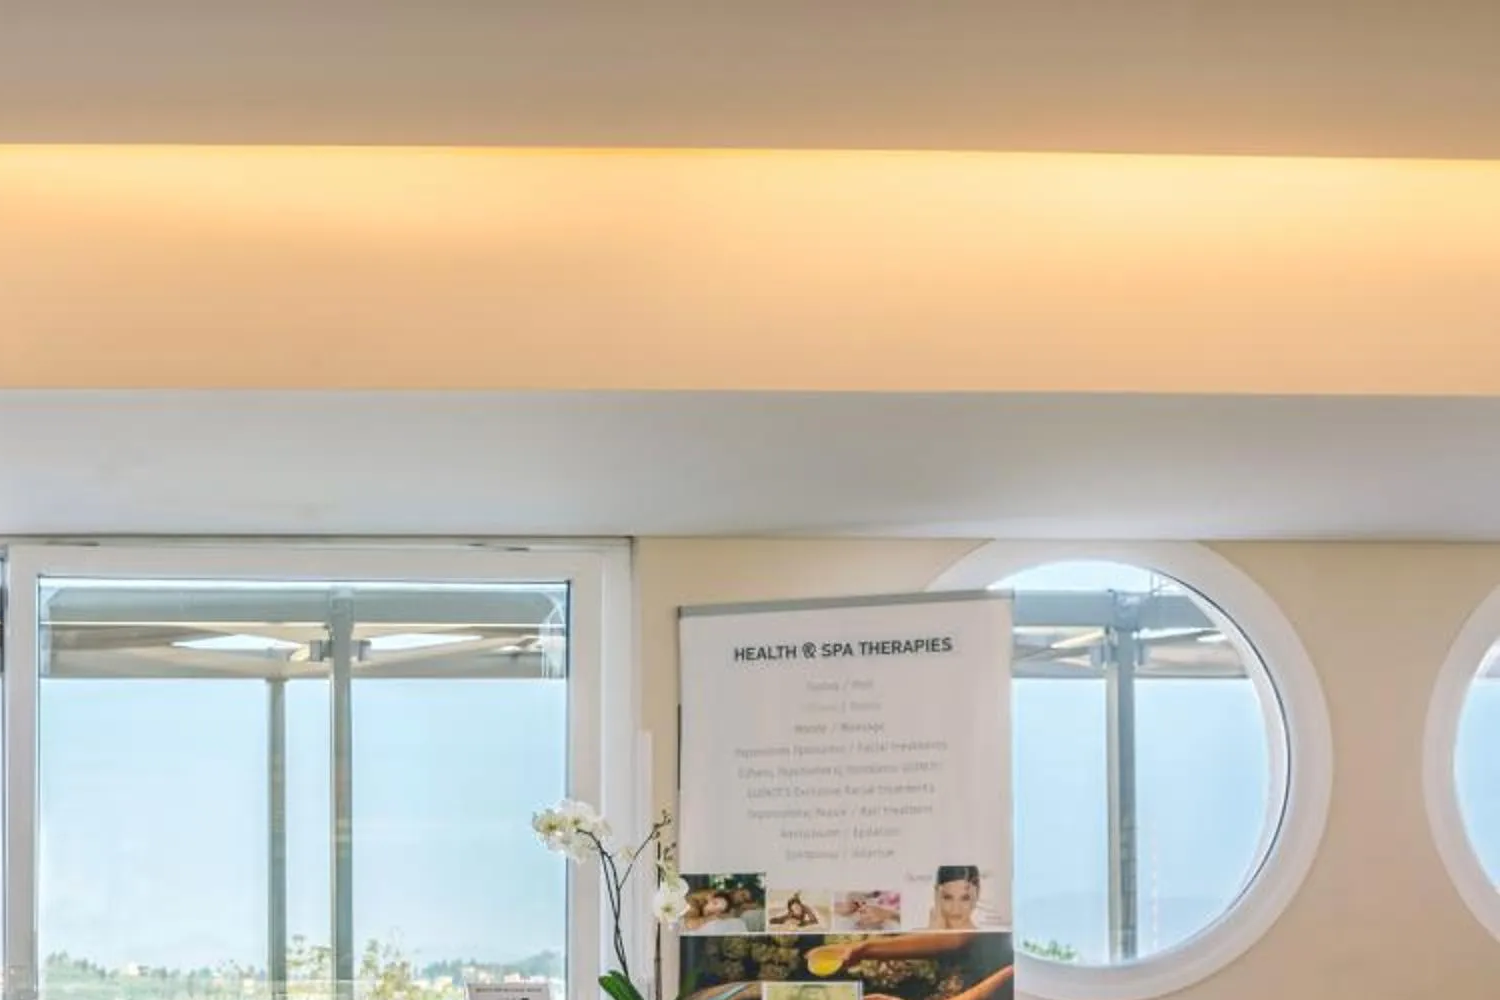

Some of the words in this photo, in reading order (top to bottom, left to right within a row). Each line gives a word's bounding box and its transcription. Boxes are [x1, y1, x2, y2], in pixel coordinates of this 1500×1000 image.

[733, 645, 798, 662] HEALTH
[802, 641, 818, 659] &
[821, 642, 855, 658] SPA
[858, 636, 954, 657] THERAPIES
